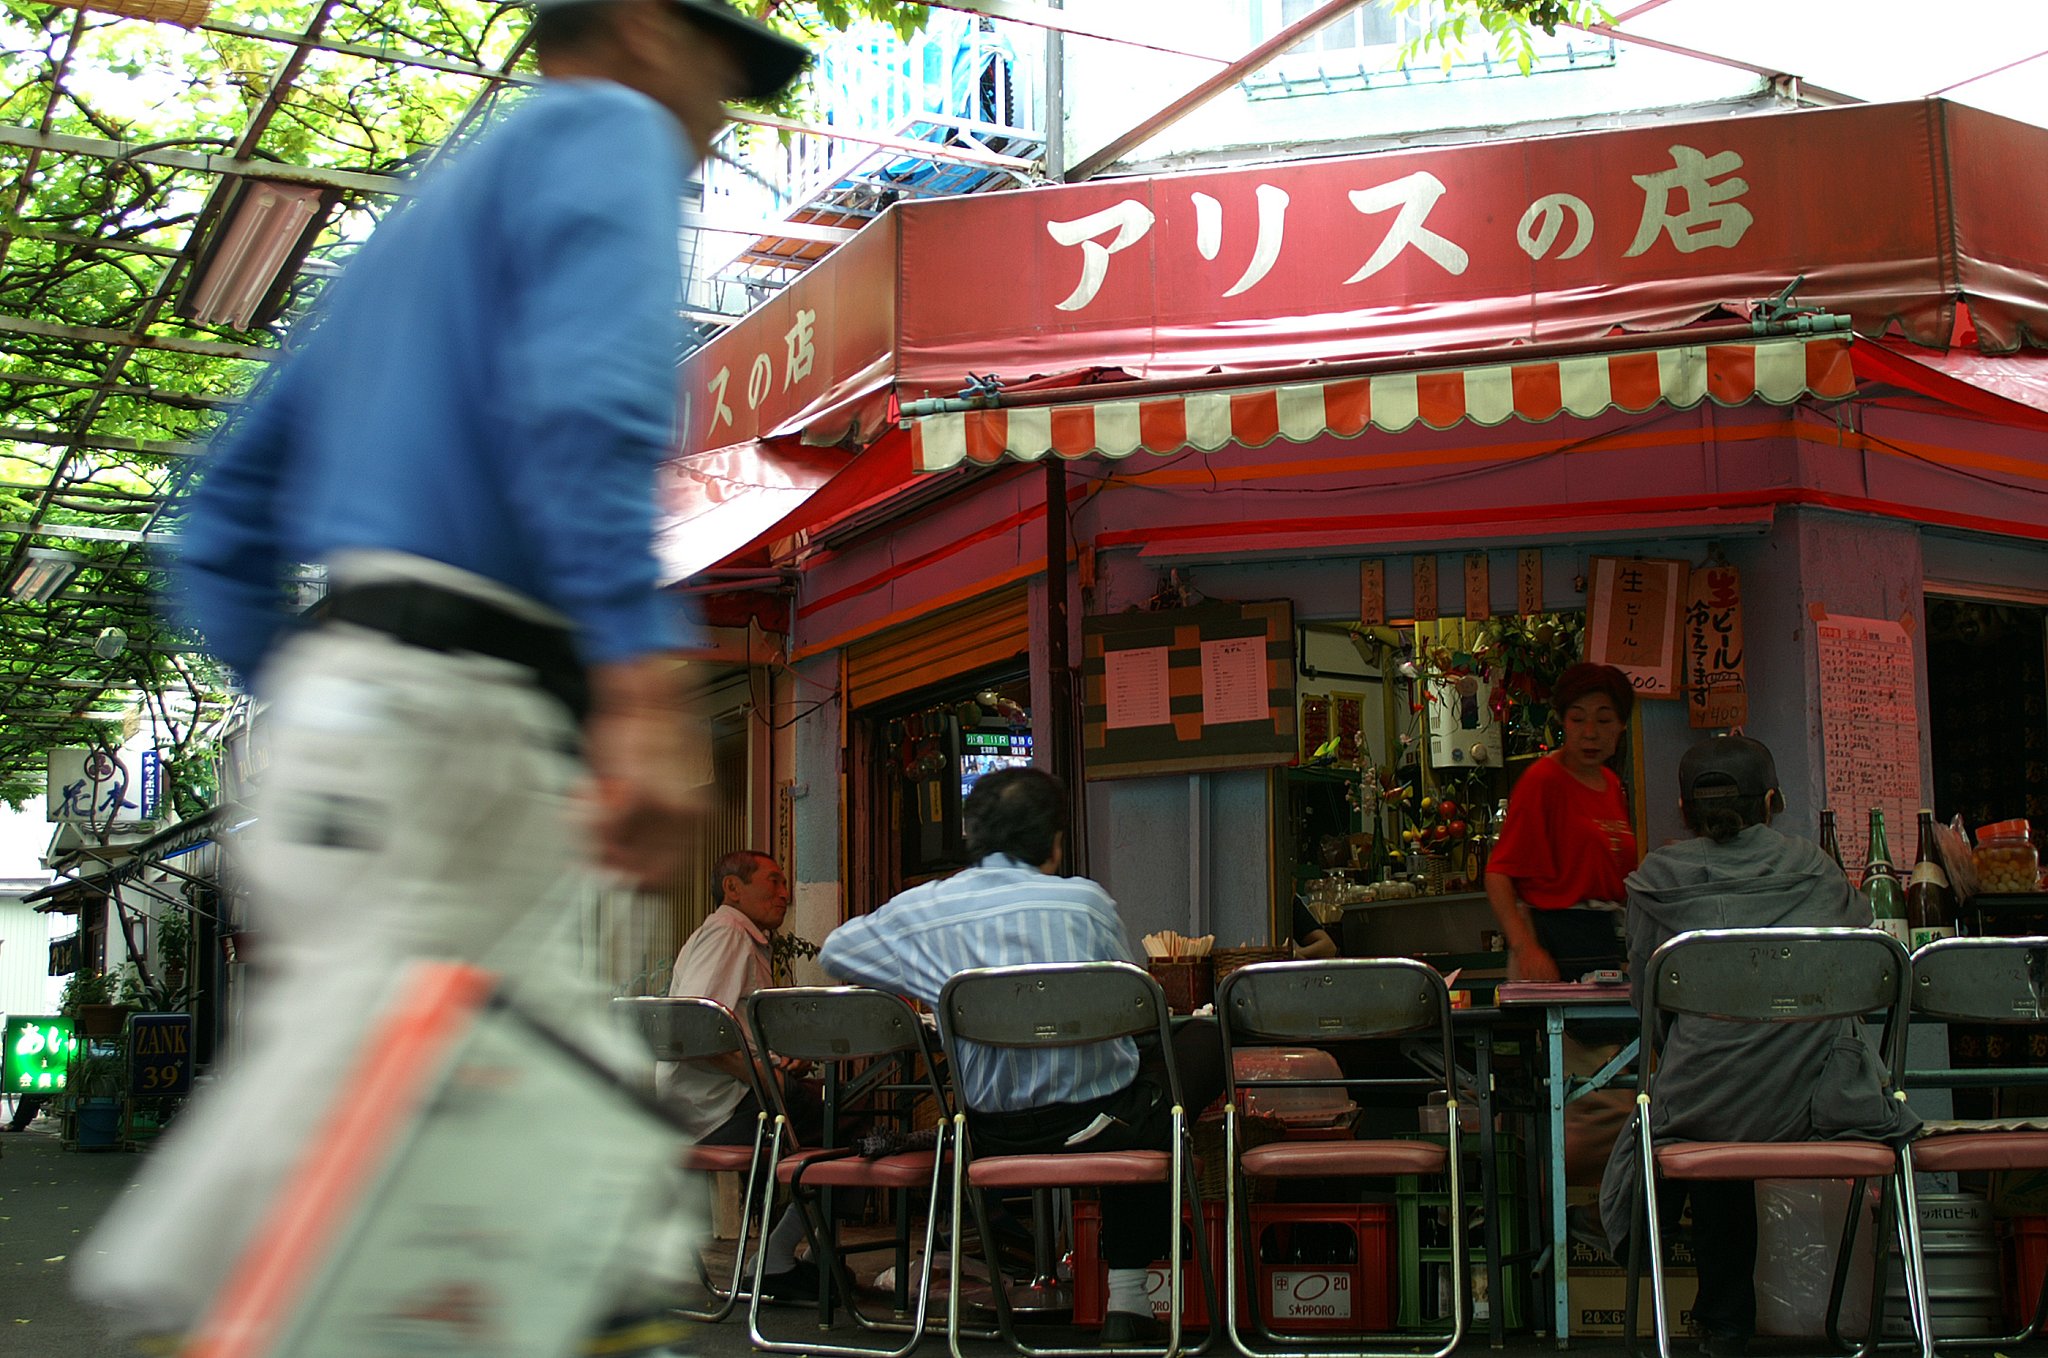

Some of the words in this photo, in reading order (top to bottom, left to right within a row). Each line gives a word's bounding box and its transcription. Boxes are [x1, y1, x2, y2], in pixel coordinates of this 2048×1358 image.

[1046, 143, 1755, 312] アリスの店
[1619, 567, 1643, 647] 生ビール
[1707, 570, 1742, 670] 生ビール
[1686, 599, 1710, 708] 冷えてます
[136, 1024, 188, 1056] ZANK
[1920, 1207, 1979, 1219] ッポロビール
[1276, 1277, 1288, 1290] 中
[1334, 1276, 1348, 1290] 20
